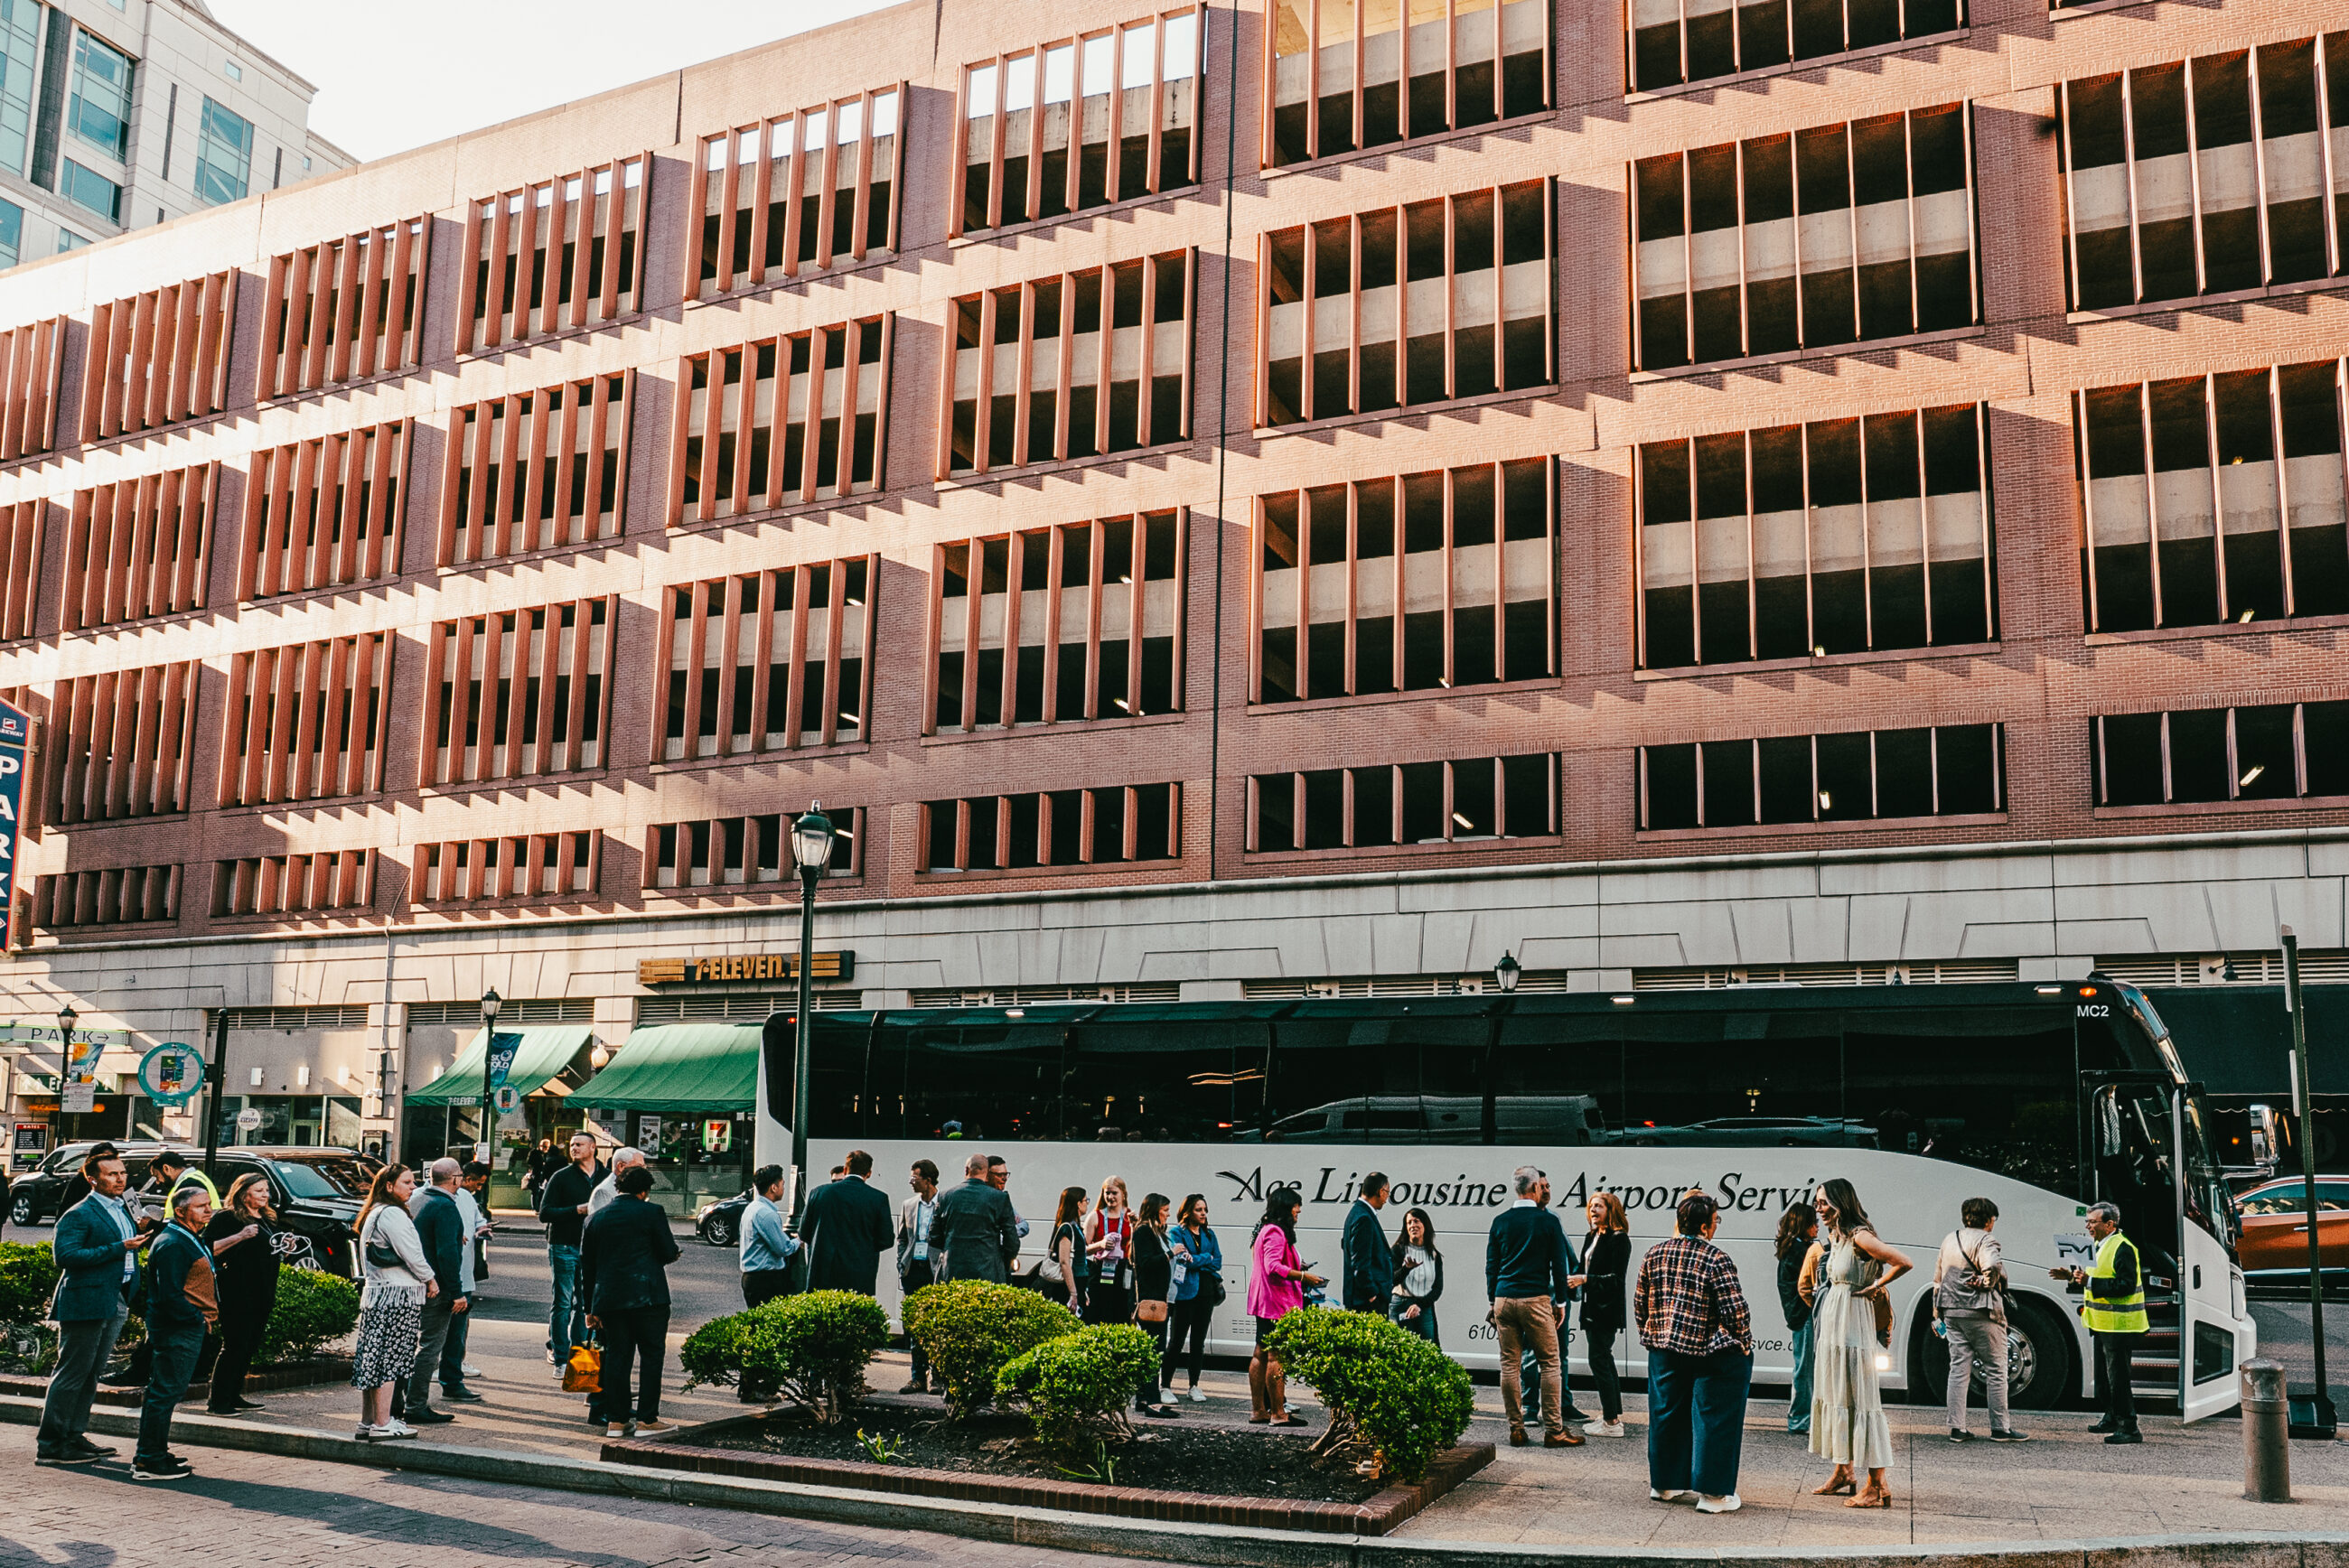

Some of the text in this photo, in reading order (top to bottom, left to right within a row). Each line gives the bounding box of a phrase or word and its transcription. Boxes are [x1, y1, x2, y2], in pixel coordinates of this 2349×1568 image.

[2077, 1005, 2110, 1017] MC2
[31, 1028, 94, 1042] PARK
[1310, 1167, 1507, 1207] Liousine
